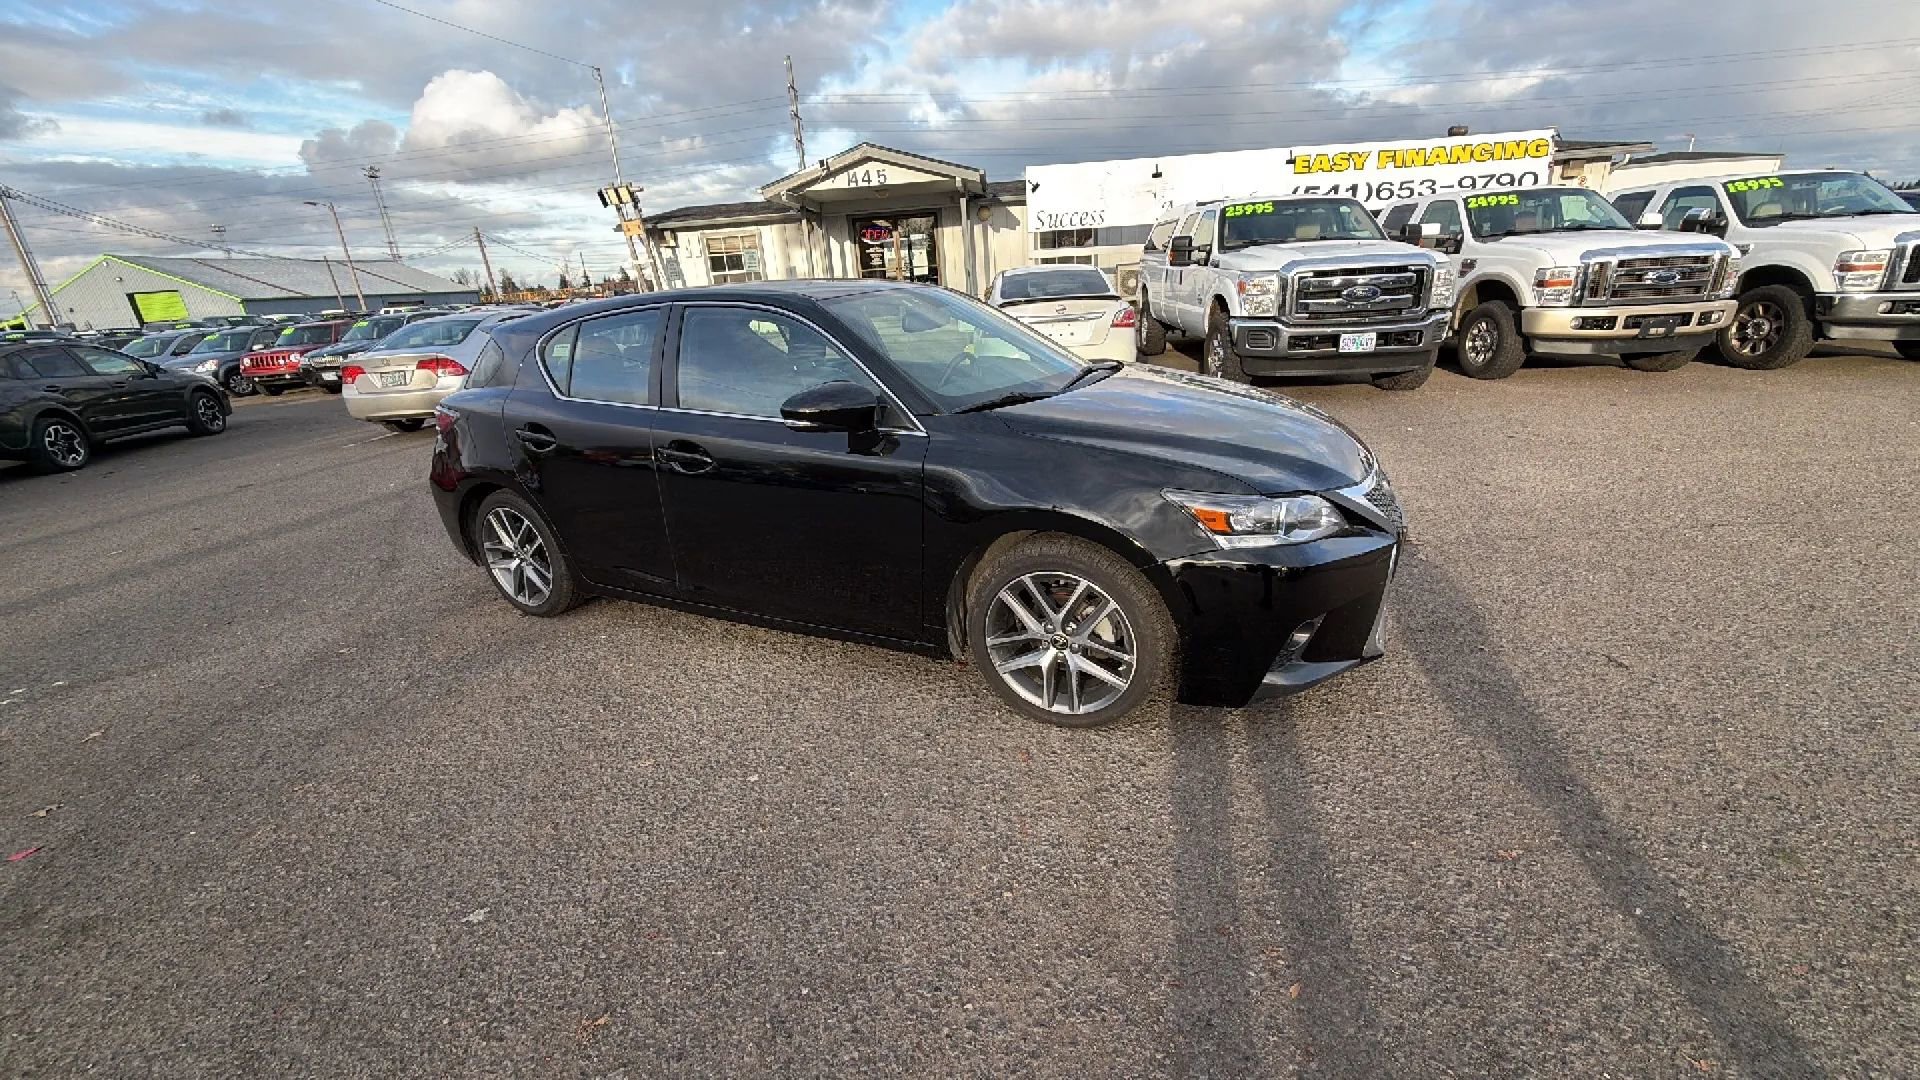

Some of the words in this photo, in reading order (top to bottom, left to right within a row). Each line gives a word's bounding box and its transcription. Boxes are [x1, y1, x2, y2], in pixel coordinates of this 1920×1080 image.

[1294, 150, 1371, 174] EASY
[1377, 138, 1549, 169] FINANCING
[1225, 201, 1275, 217] 25995
[1467, 194, 1519, 209] 24995
[1035, 208, 1106, 231] Success
